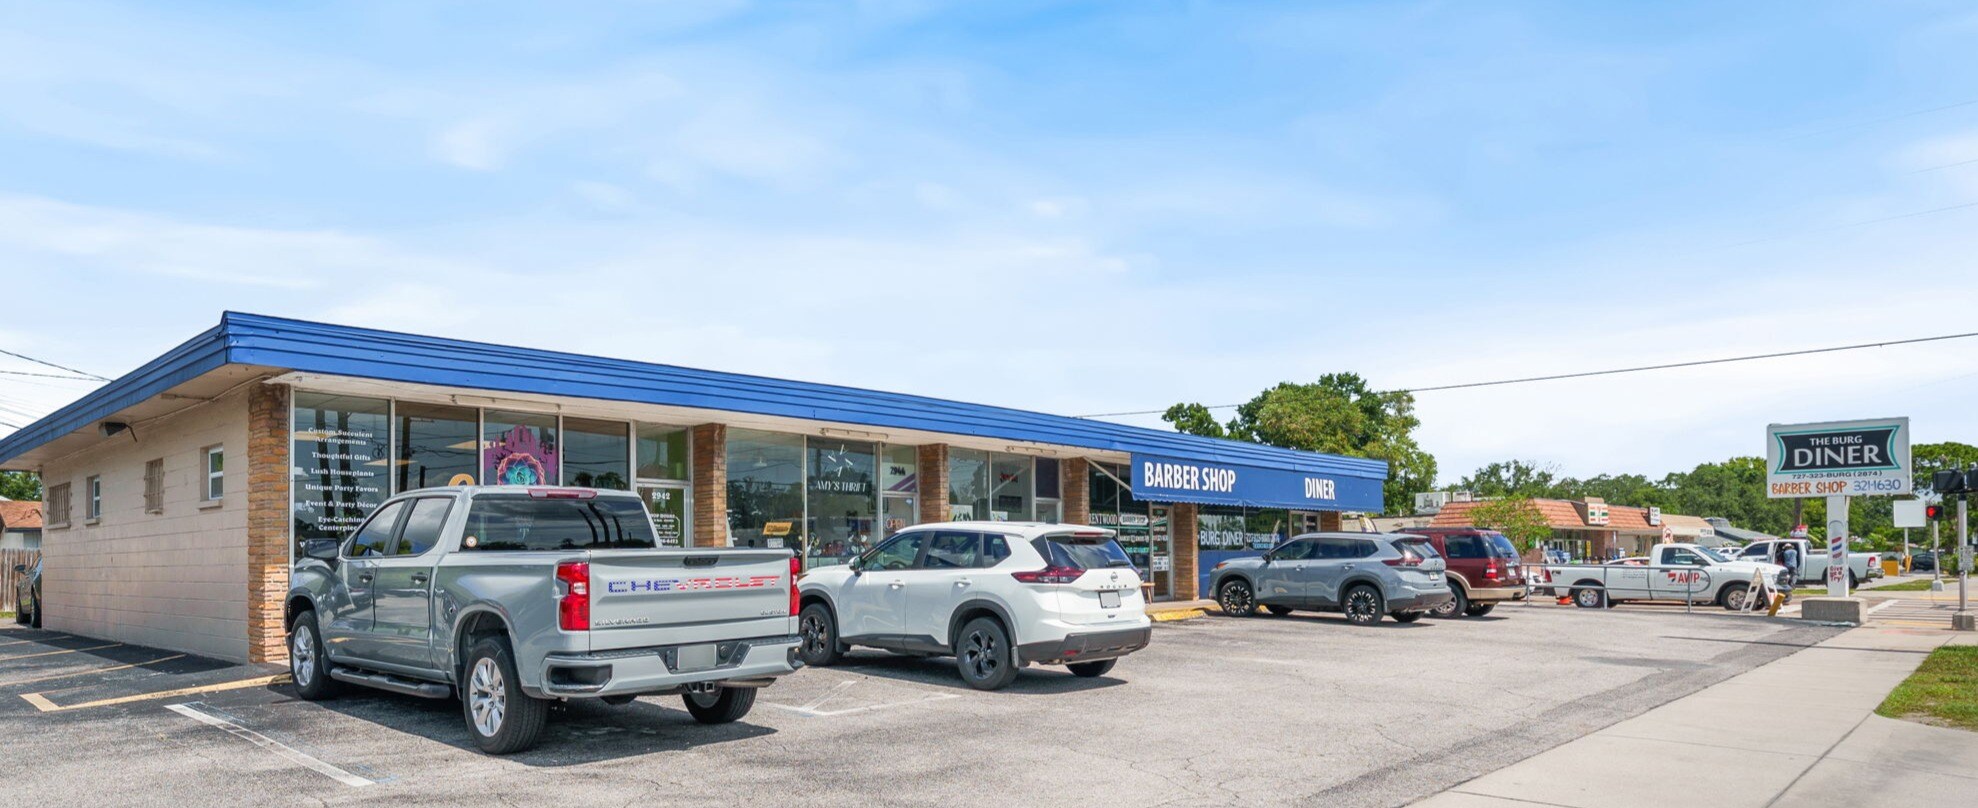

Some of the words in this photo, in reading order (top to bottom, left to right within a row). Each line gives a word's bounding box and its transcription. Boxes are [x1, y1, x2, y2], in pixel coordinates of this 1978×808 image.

[308, 427, 336, 436] Custom
[338, 429, 373, 438] Succulent
[315, 437, 366, 446] Arrangements
[1809, 437, 1830, 446] THE
[1832, 435, 1862, 445] BURG
[312, 452, 352, 461] Thoughtful
[1794, 444, 1882, 467] DINER
[330, 469, 374, 477] Houseplants
[1144, 462, 1199, 490] BARBER
[1202, 467, 1236, 493] SHOP
[305, 484, 332, 492] Unique
[334, 485, 353, 493] Party
[816, 480, 840, 491] AMY'S
[841, 482, 866, 493] THRIFT
[1304, 477, 1335, 500] DINER
[1772, 482, 1811, 495] BARBER
[1816, 481, 1847, 494] SHOP
[651, 492, 671, 500] 2942
[336, 501, 355, 509] Party
[357, 500, 377, 509] Décor
[1200, 531, 1220, 545] BURG
[1222, 531, 1244, 546] DINER
[609, 575, 780, 593] CHEVROLET
